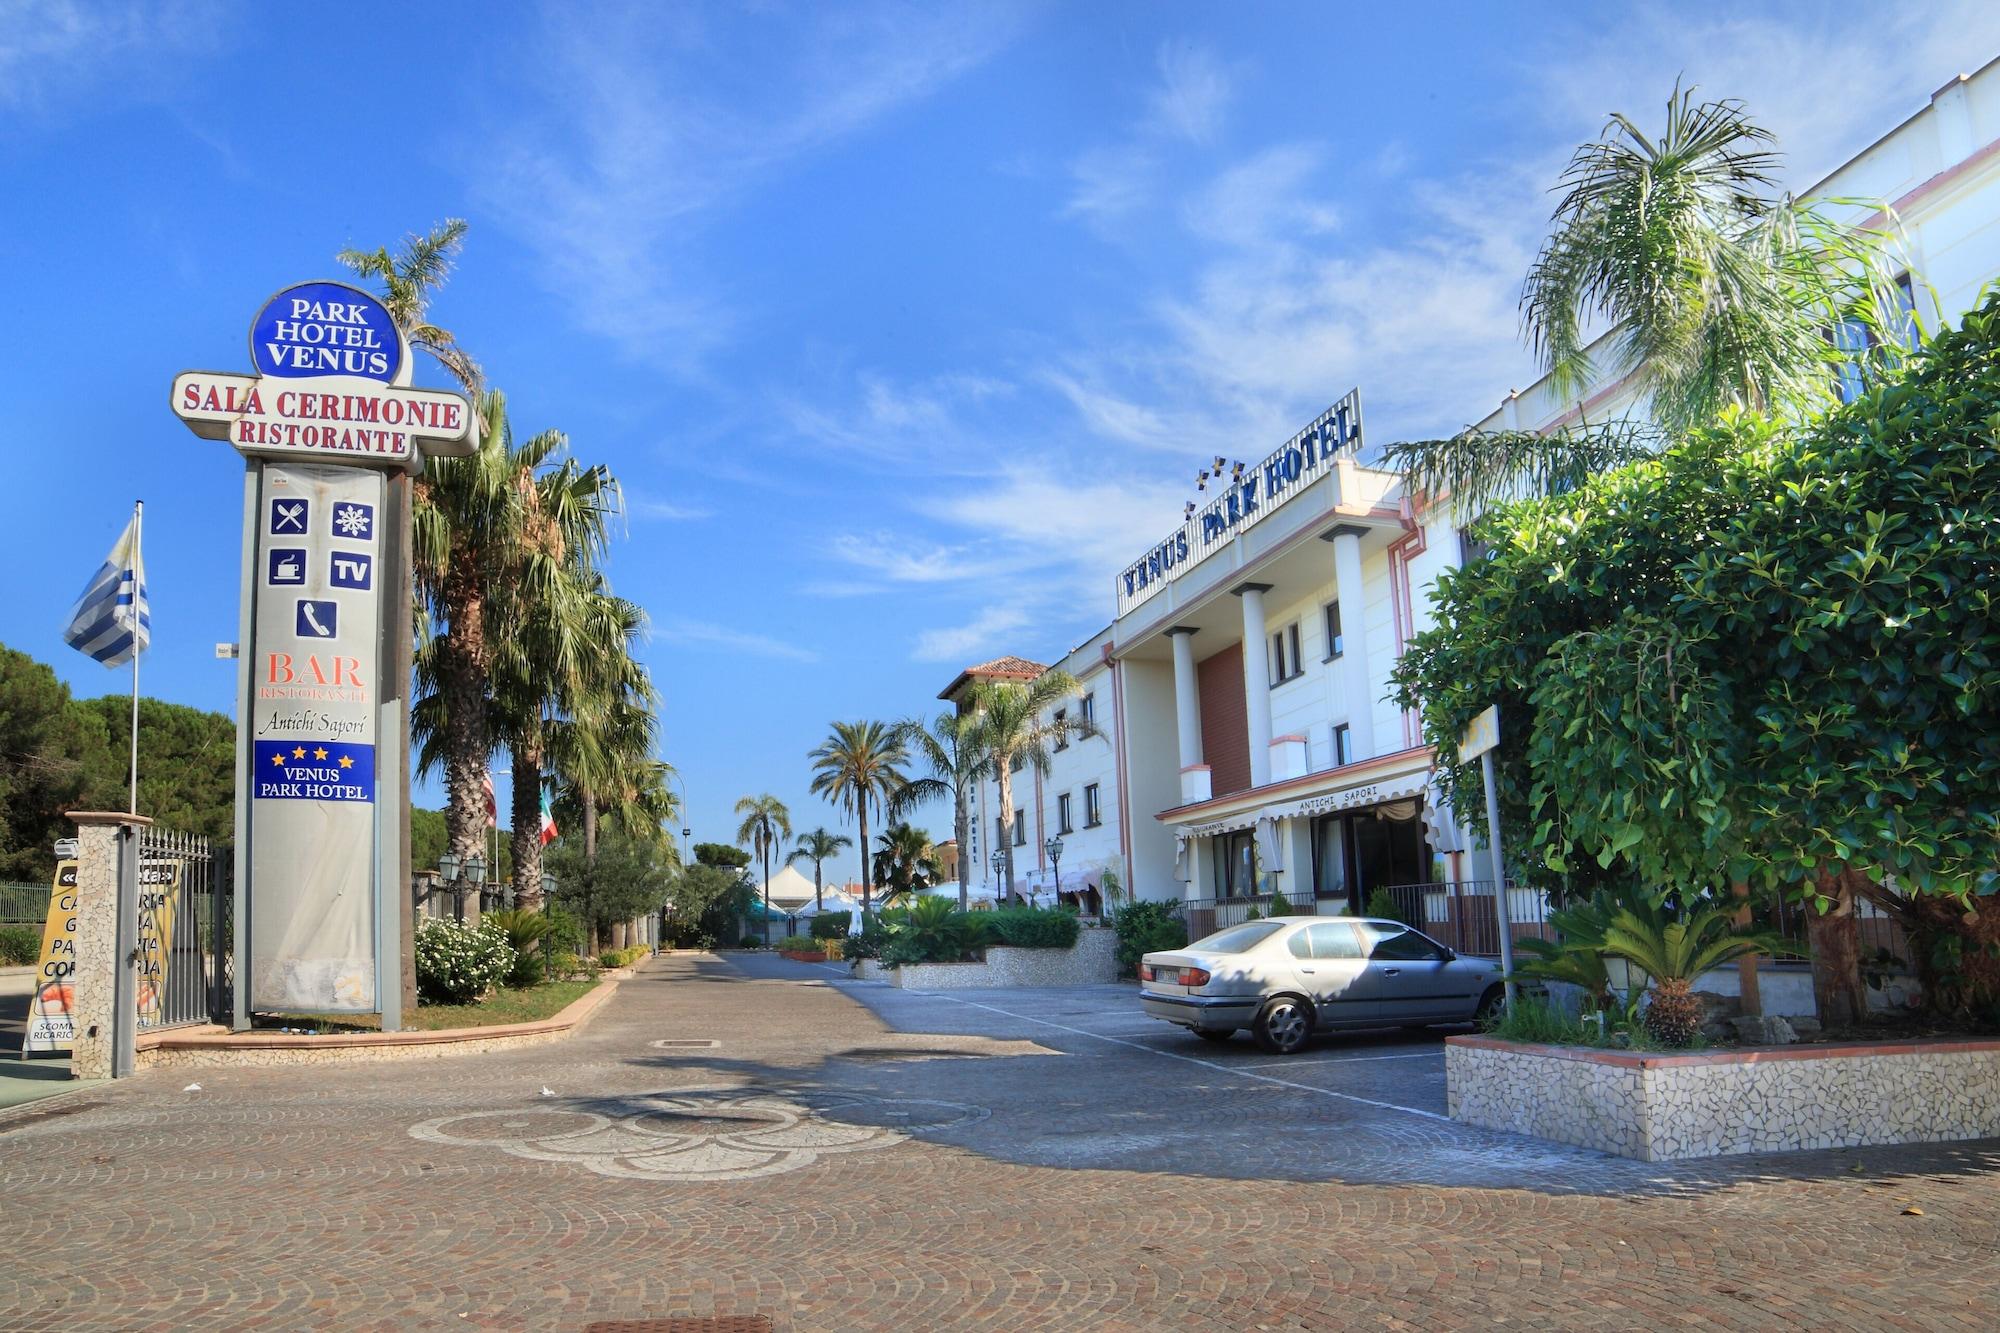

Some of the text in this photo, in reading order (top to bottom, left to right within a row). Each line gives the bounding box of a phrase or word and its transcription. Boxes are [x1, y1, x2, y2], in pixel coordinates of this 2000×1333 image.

[291, 299, 368, 325] PARK
[274, 321, 382, 350] HOTEL
[266, 344, 388, 375] VENUS
[183, 384, 461, 430] SALA CERIMONIE
[238, 421, 406, 454] RISTORANTE
[1123, 406, 1358, 598] VENUS PARK HOTEL
[334, 559, 368, 582] TV
[267, 652, 365, 688] BAR
[259, 687, 368, 703] RISTORANTE
[259, 710, 367, 740] Antichi Sapori
[284, 768, 340, 782] VENUS
[261, 783, 368, 799] PARK HOTEL
[1300, 786, 1377, 809] ANTICHI SAPORI
